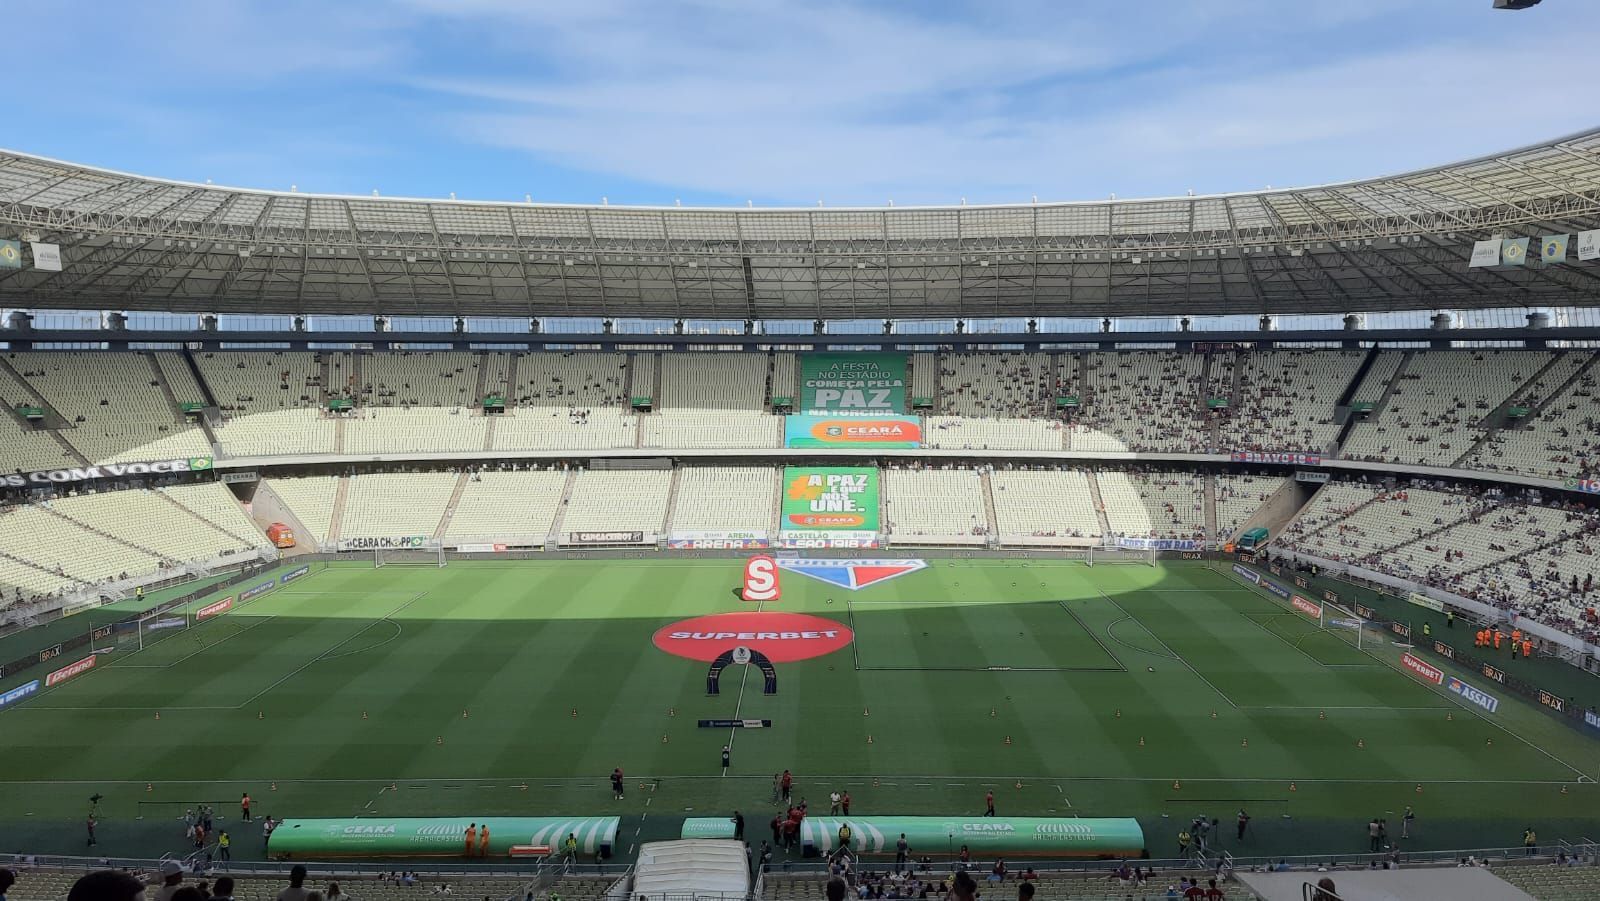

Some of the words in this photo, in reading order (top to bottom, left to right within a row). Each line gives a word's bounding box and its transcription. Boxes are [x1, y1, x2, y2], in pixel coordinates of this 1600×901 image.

[831, 362, 840, 371] A
[842, 362, 879, 371] FESTA
[818, 371, 837, 379] NO
[839, 369, 891, 379] ESTÁDIO
[806, 380, 865, 389] COMEÇA
[867, 380, 903, 388] PELA
[815, 389, 893, 408] PAZ
[847, 426, 903, 434] CEARÁ
[1246, 453, 1289, 464] BRAVO
[1293, 454, 1306, 464] 18
[30, 465, 102, 483] COM
[807, 475, 823, 487] A
[826, 474, 868, 487] PAZ
[810, 499, 866, 512] UNE.
[692, 540, 744, 549] ARENA
[1148, 539, 1173, 550] OPEN
[1174, 540, 1194, 550] BAR
[1182, 552, 1202, 560] BRAX
[747, 559, 774, 592] S
[199, 598, 233, 617] SUPERBET
[94, 627, 112, 641] BRAX
[669, 631, 839, 640] SUPERBET
[1394, 623, 1409, 638] BRAX
[41, 646, 61, 662] BRAX
[1436, 643, 1454, 658] BRAX
[52, 659, 94, 683] Betano
[1403, 658, 1440, 683] SUPERBET
[1485, 666, 1504, 684] BRAX
[1541, 693, 1563, 712] BRAX
